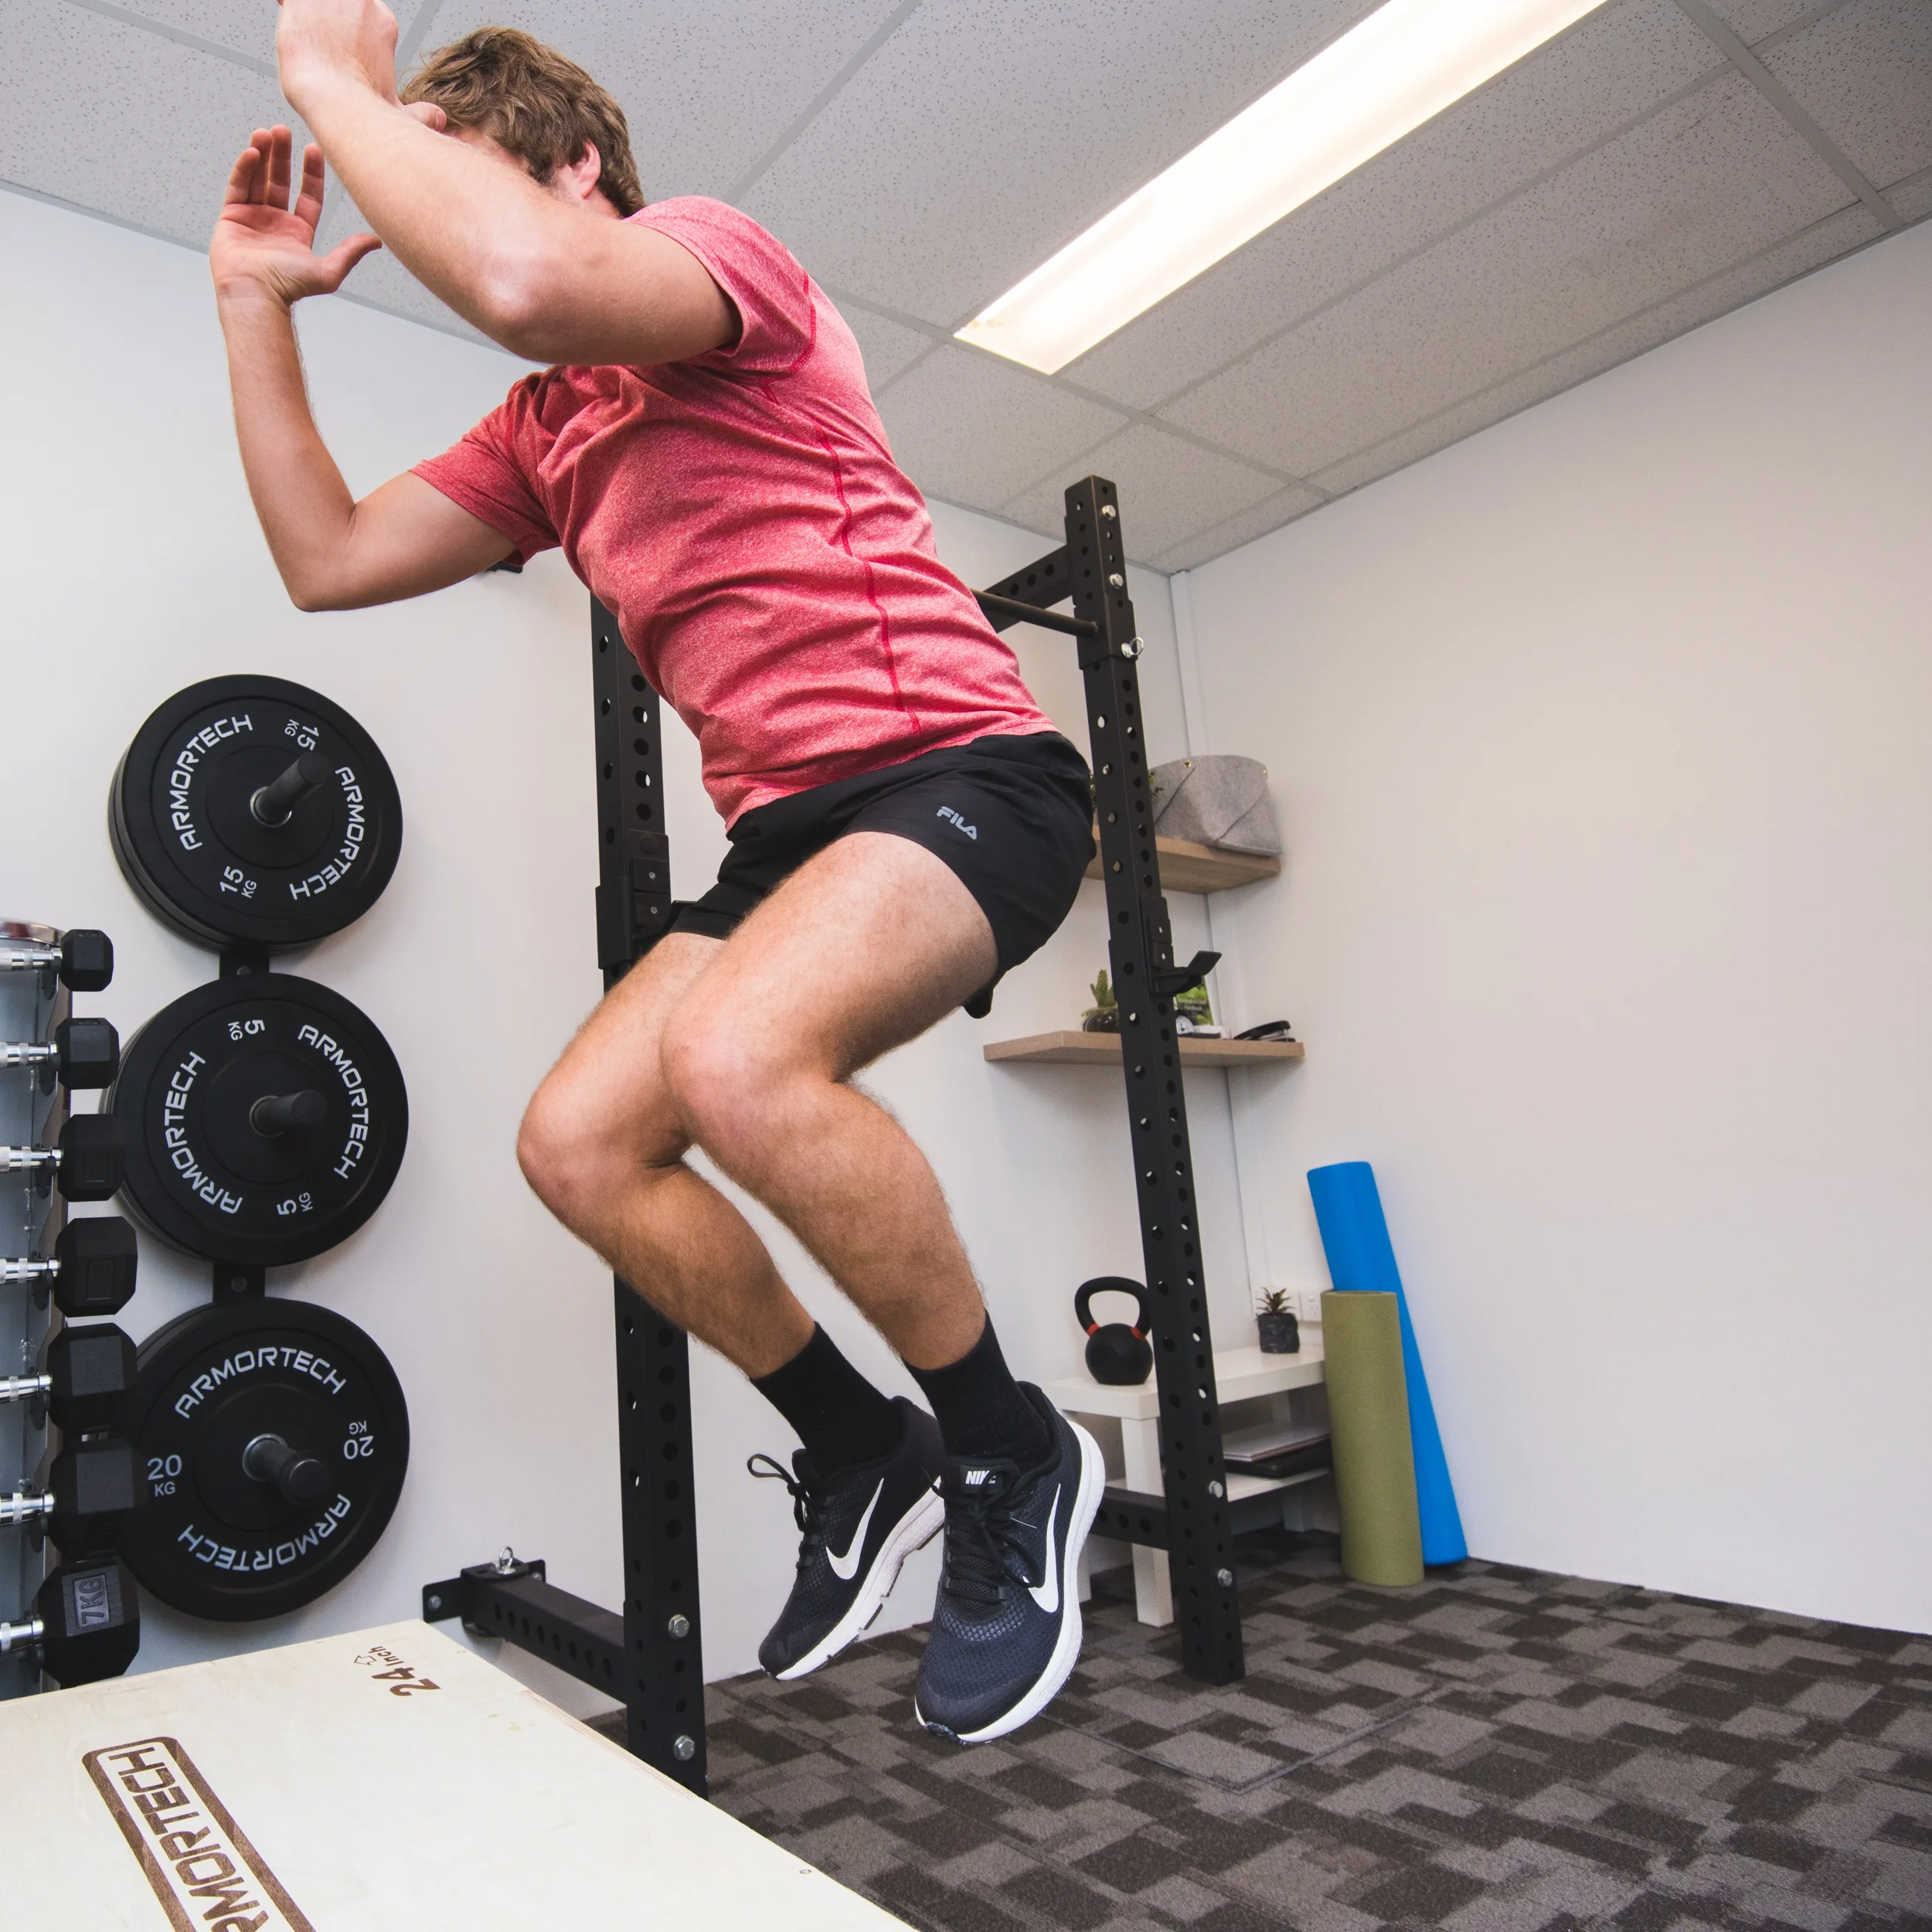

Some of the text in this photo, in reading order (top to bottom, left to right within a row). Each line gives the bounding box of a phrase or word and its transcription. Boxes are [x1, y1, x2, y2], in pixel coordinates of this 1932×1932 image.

[284, 719, 299, 736] KG
[298, 726, 319, 750] 15
[170, 714, 253, 850] ARMORTECH
[289, 767, 365, 900] ARMORTECH
[936, 806, 977, 840] FILA
[219, 866, 243, 893] 15
[241, 879, 257, 899] KG
[228, 1021, 243, 1041] KG
[245, 1019, 265, 1035] 5
[298, 1025, 369, 1179] ARMORTECH
[165, 1051, 243, 1214] ARMORTECH
[277, 1199, 297, 1216] 5
[298, 1192, 313, 1212] KG
[175, 1347, 346, 1419] ARMORTECH
[349, 1420, 367, 1435] KG
[343, 1436, 374, 1460] 20
[148, 1454, 182, 1480] 20
[155, 1481, 175, 1497] KG
[178, 1494, 351, 1571] ARMORTECH
[368, 1645, 441, 1696] 24 Inch
